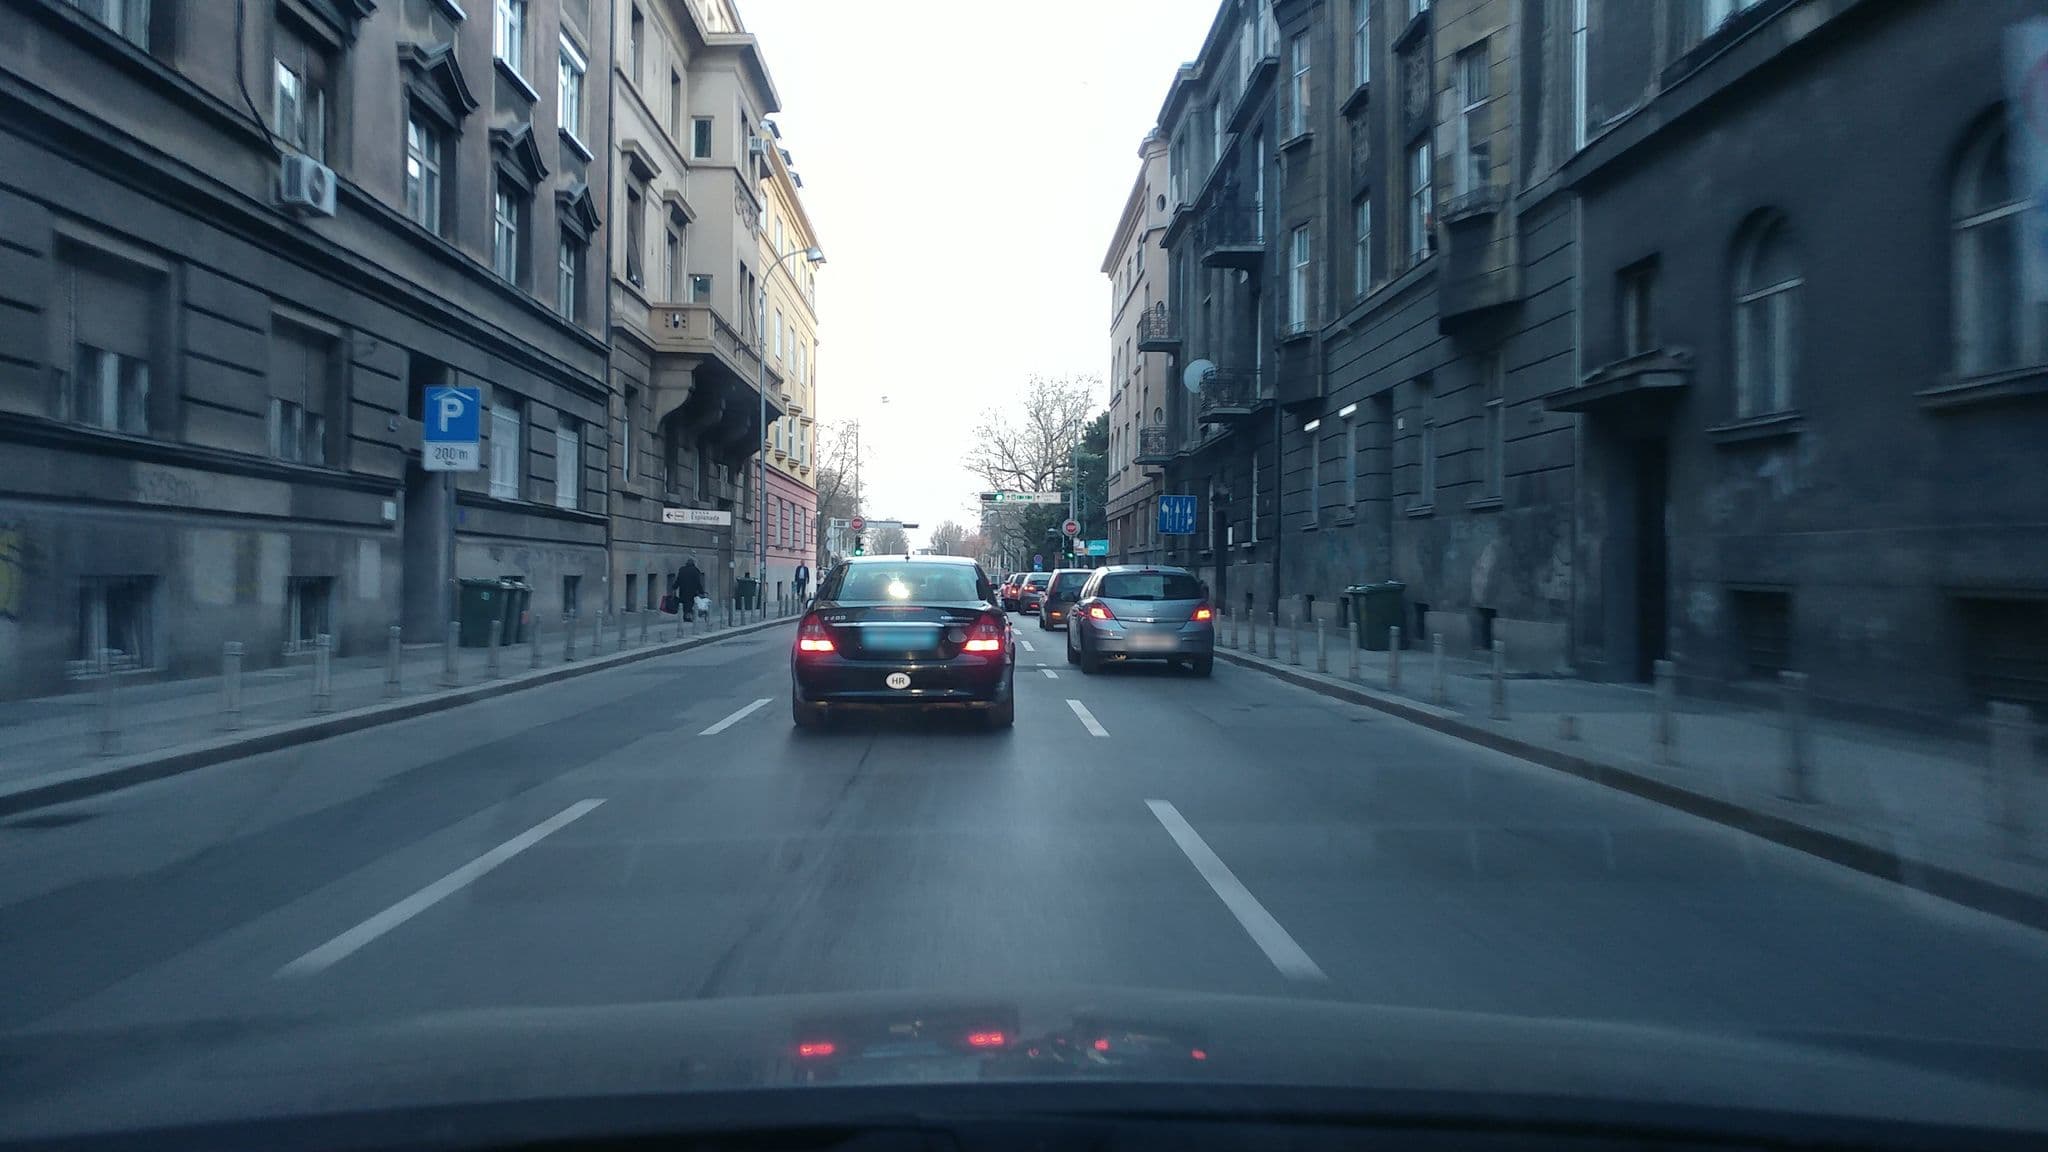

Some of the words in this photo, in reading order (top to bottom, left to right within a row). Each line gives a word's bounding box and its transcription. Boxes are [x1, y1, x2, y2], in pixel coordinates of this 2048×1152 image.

[440, 398, 464, 432] P
[458, 450, 468, 459] m
[891, 676, 905, 686] HR
